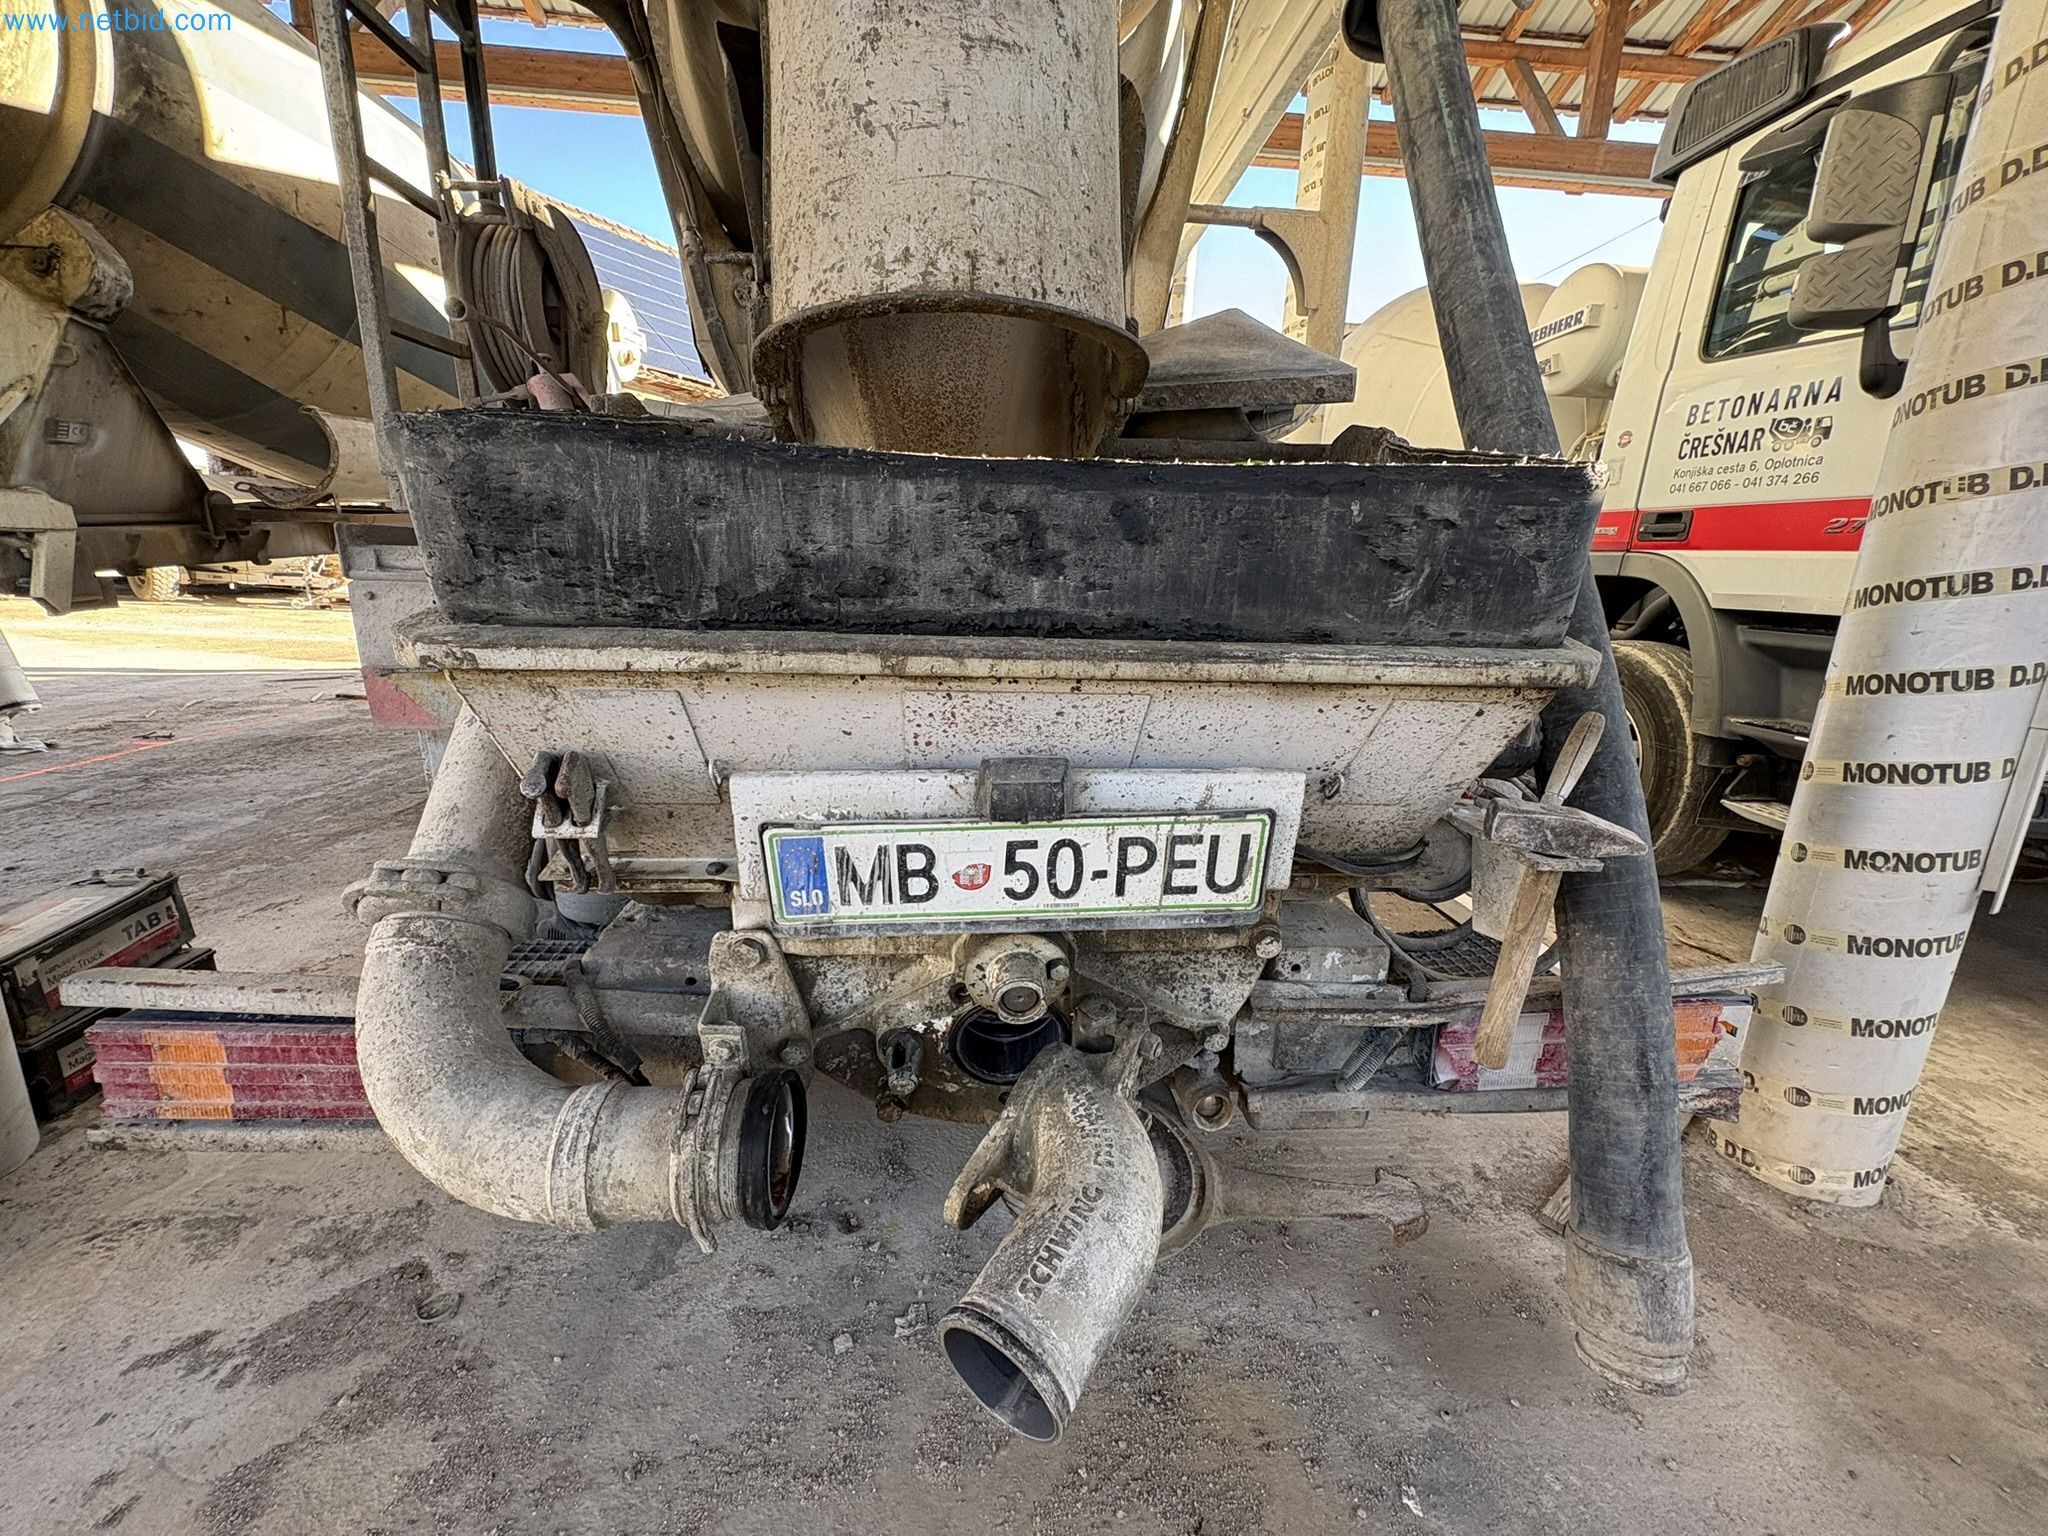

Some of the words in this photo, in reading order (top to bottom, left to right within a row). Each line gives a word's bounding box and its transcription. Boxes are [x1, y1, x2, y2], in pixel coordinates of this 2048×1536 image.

[2005, 357, 2048, 390] D.
[1685, 376, 1843, 428] BETONARNA
[1677, 426, 1766, 461] ČREŠNAR
[1673, 465, 1714, 480] Konjiška
[1717, 461, 1746, 475] cesta
[1749, 460, 1760, 474] 6,
[1765, 454, 1824, 473] Oplotnica
[2009, 462, 2048, 491] D.
[1669, 482, 1686, 495] 041
[1688, 480, 1708, 493] 667
[1710, 479, 1732, 491] 066
[1742, 476, 1763, 489] 041
[1766, 474, 1789, 487] 374
[1793, 471, 1821, 485] 266
[1853, 571, 1994, 610] MONOTUB
[1845, 668, 1995, 697] MONOTUB
[1842, 761, 1991, 785] MONOTUB
[835, 844, 939, 906] MB
[1003, 833, 1252, 902] 50-PEU
[1844, 848, 1982, 874] MONOTUB
[791, 888, 824, 907] SLO
[121, 911, 162, 942] TAB
[1847, 930, 1966, 958] MONOTUB
[77, 949, 105, 970] Truck
[1017, 1183, 1105, 1304] SCHWING
